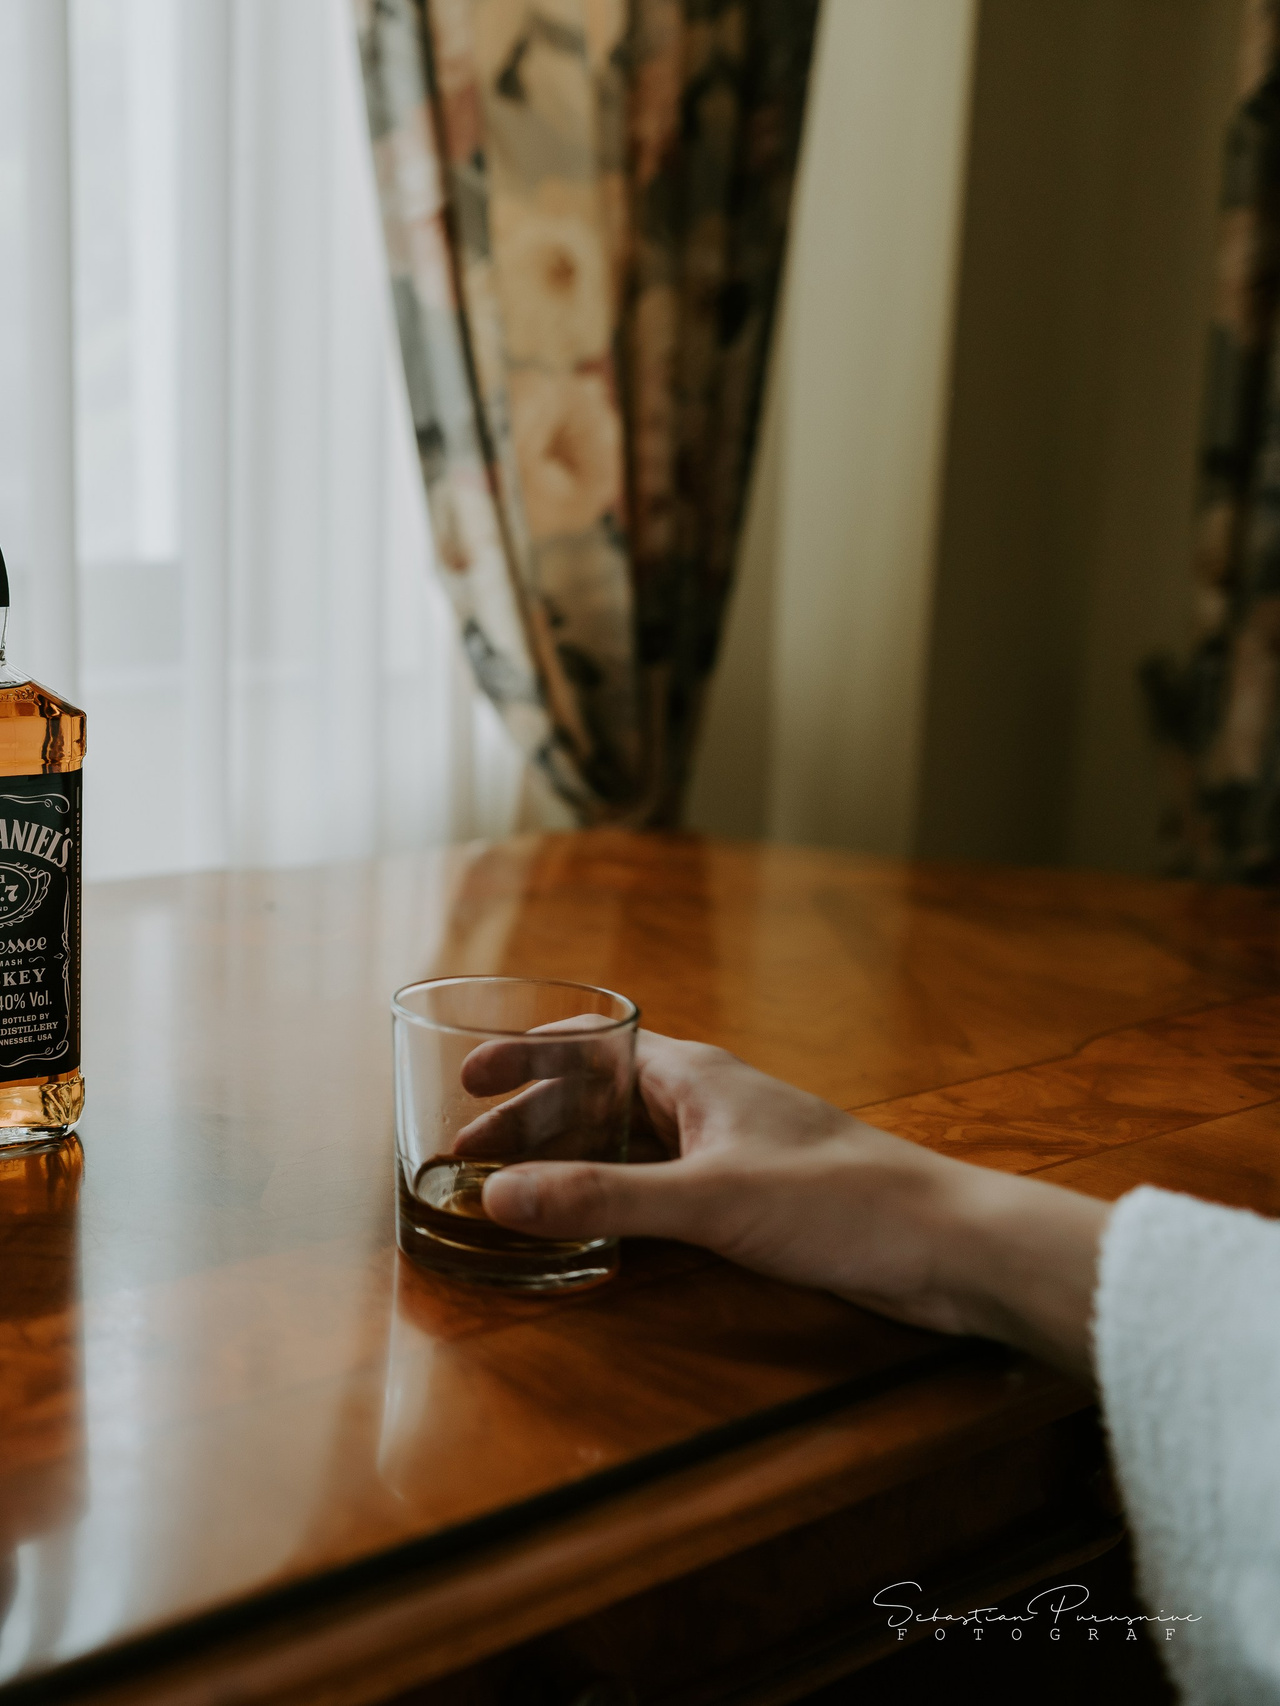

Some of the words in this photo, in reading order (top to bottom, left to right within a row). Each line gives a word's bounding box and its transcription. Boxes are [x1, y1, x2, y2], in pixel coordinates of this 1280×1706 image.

[29, 990, 52, 1007] Vol.
[2, 1015, 37, 1025] BOTTLED
[39, 1013, 50, 1021] BY
[0, 1021, 59, 1036] DISTILLERY
[37, 1033, 52, 1041] USA
